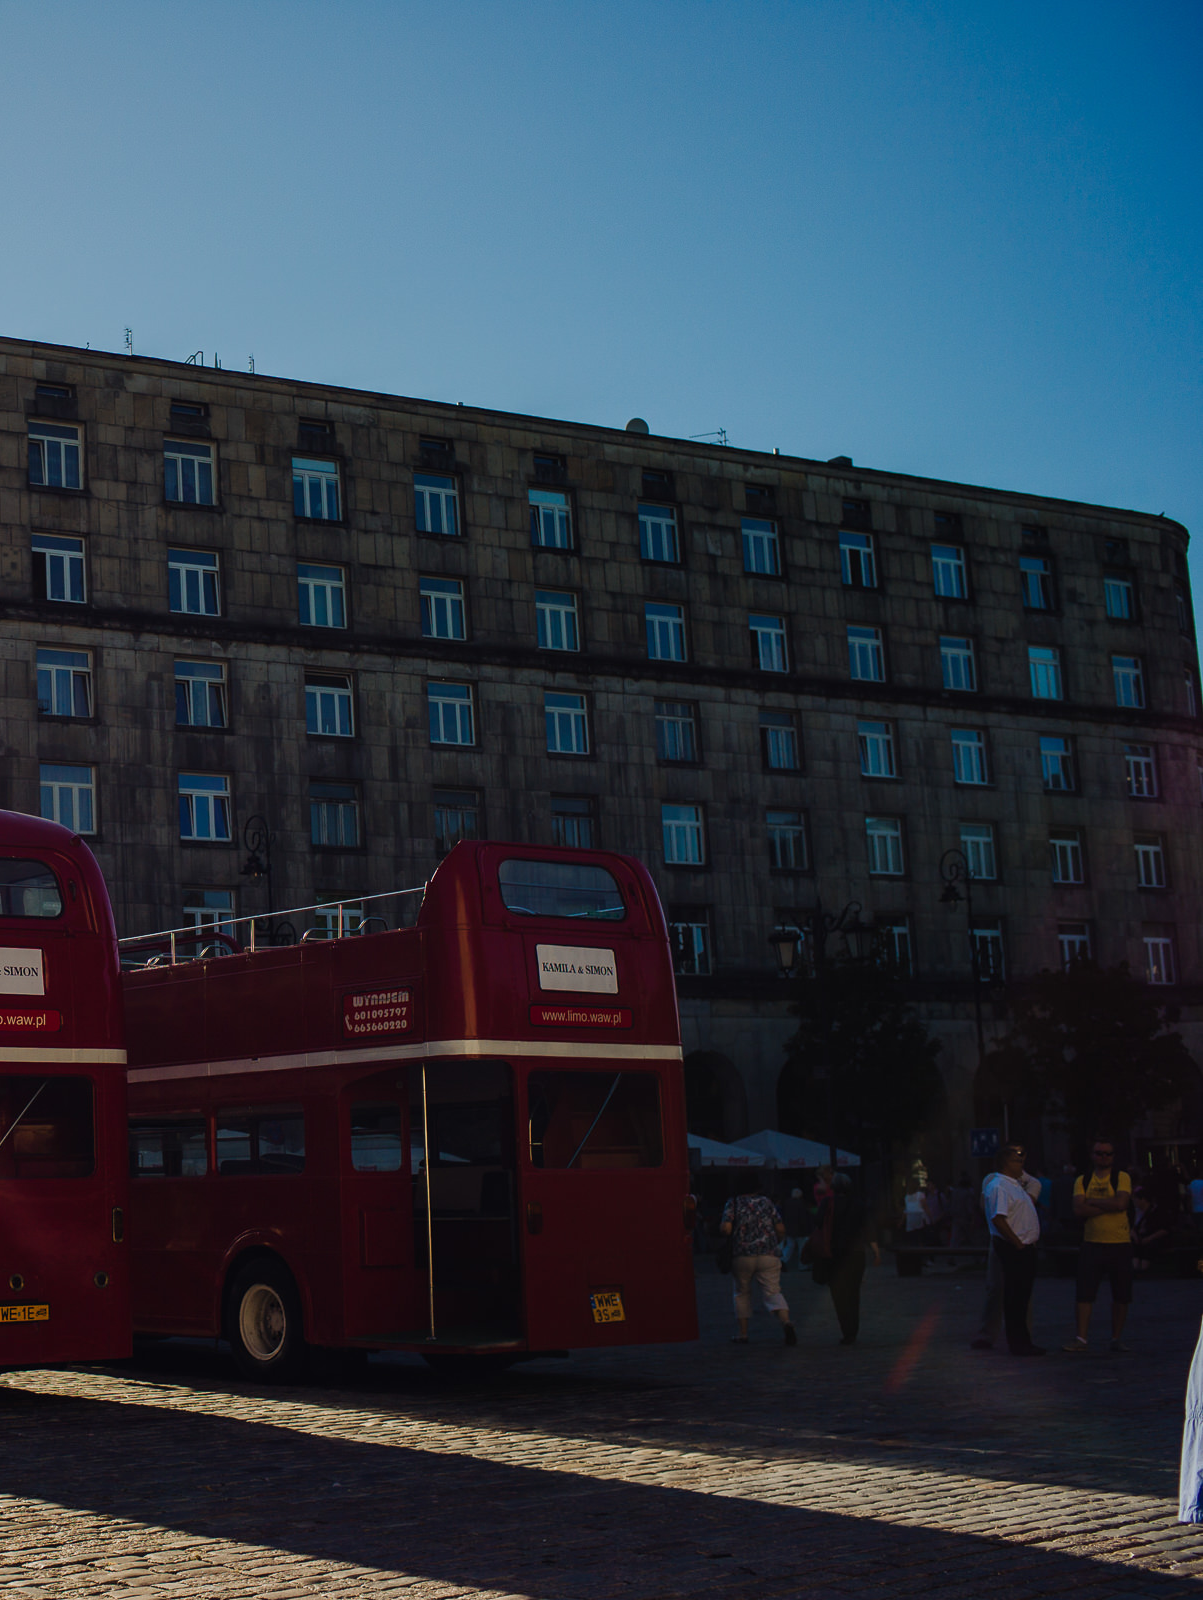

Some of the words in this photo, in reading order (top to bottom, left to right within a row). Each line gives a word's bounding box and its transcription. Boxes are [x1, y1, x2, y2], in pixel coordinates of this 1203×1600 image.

[3, 966, 39, 977] SIMON
[542, 962, 576, 974] KAMILA
[577, 967, 584, 975] &
[585, 965, 614, 976] SIMON
[354, 1007, 407, 1020] 601095797
[541, 1009, 622, 1026] www.limo.waw.pl
